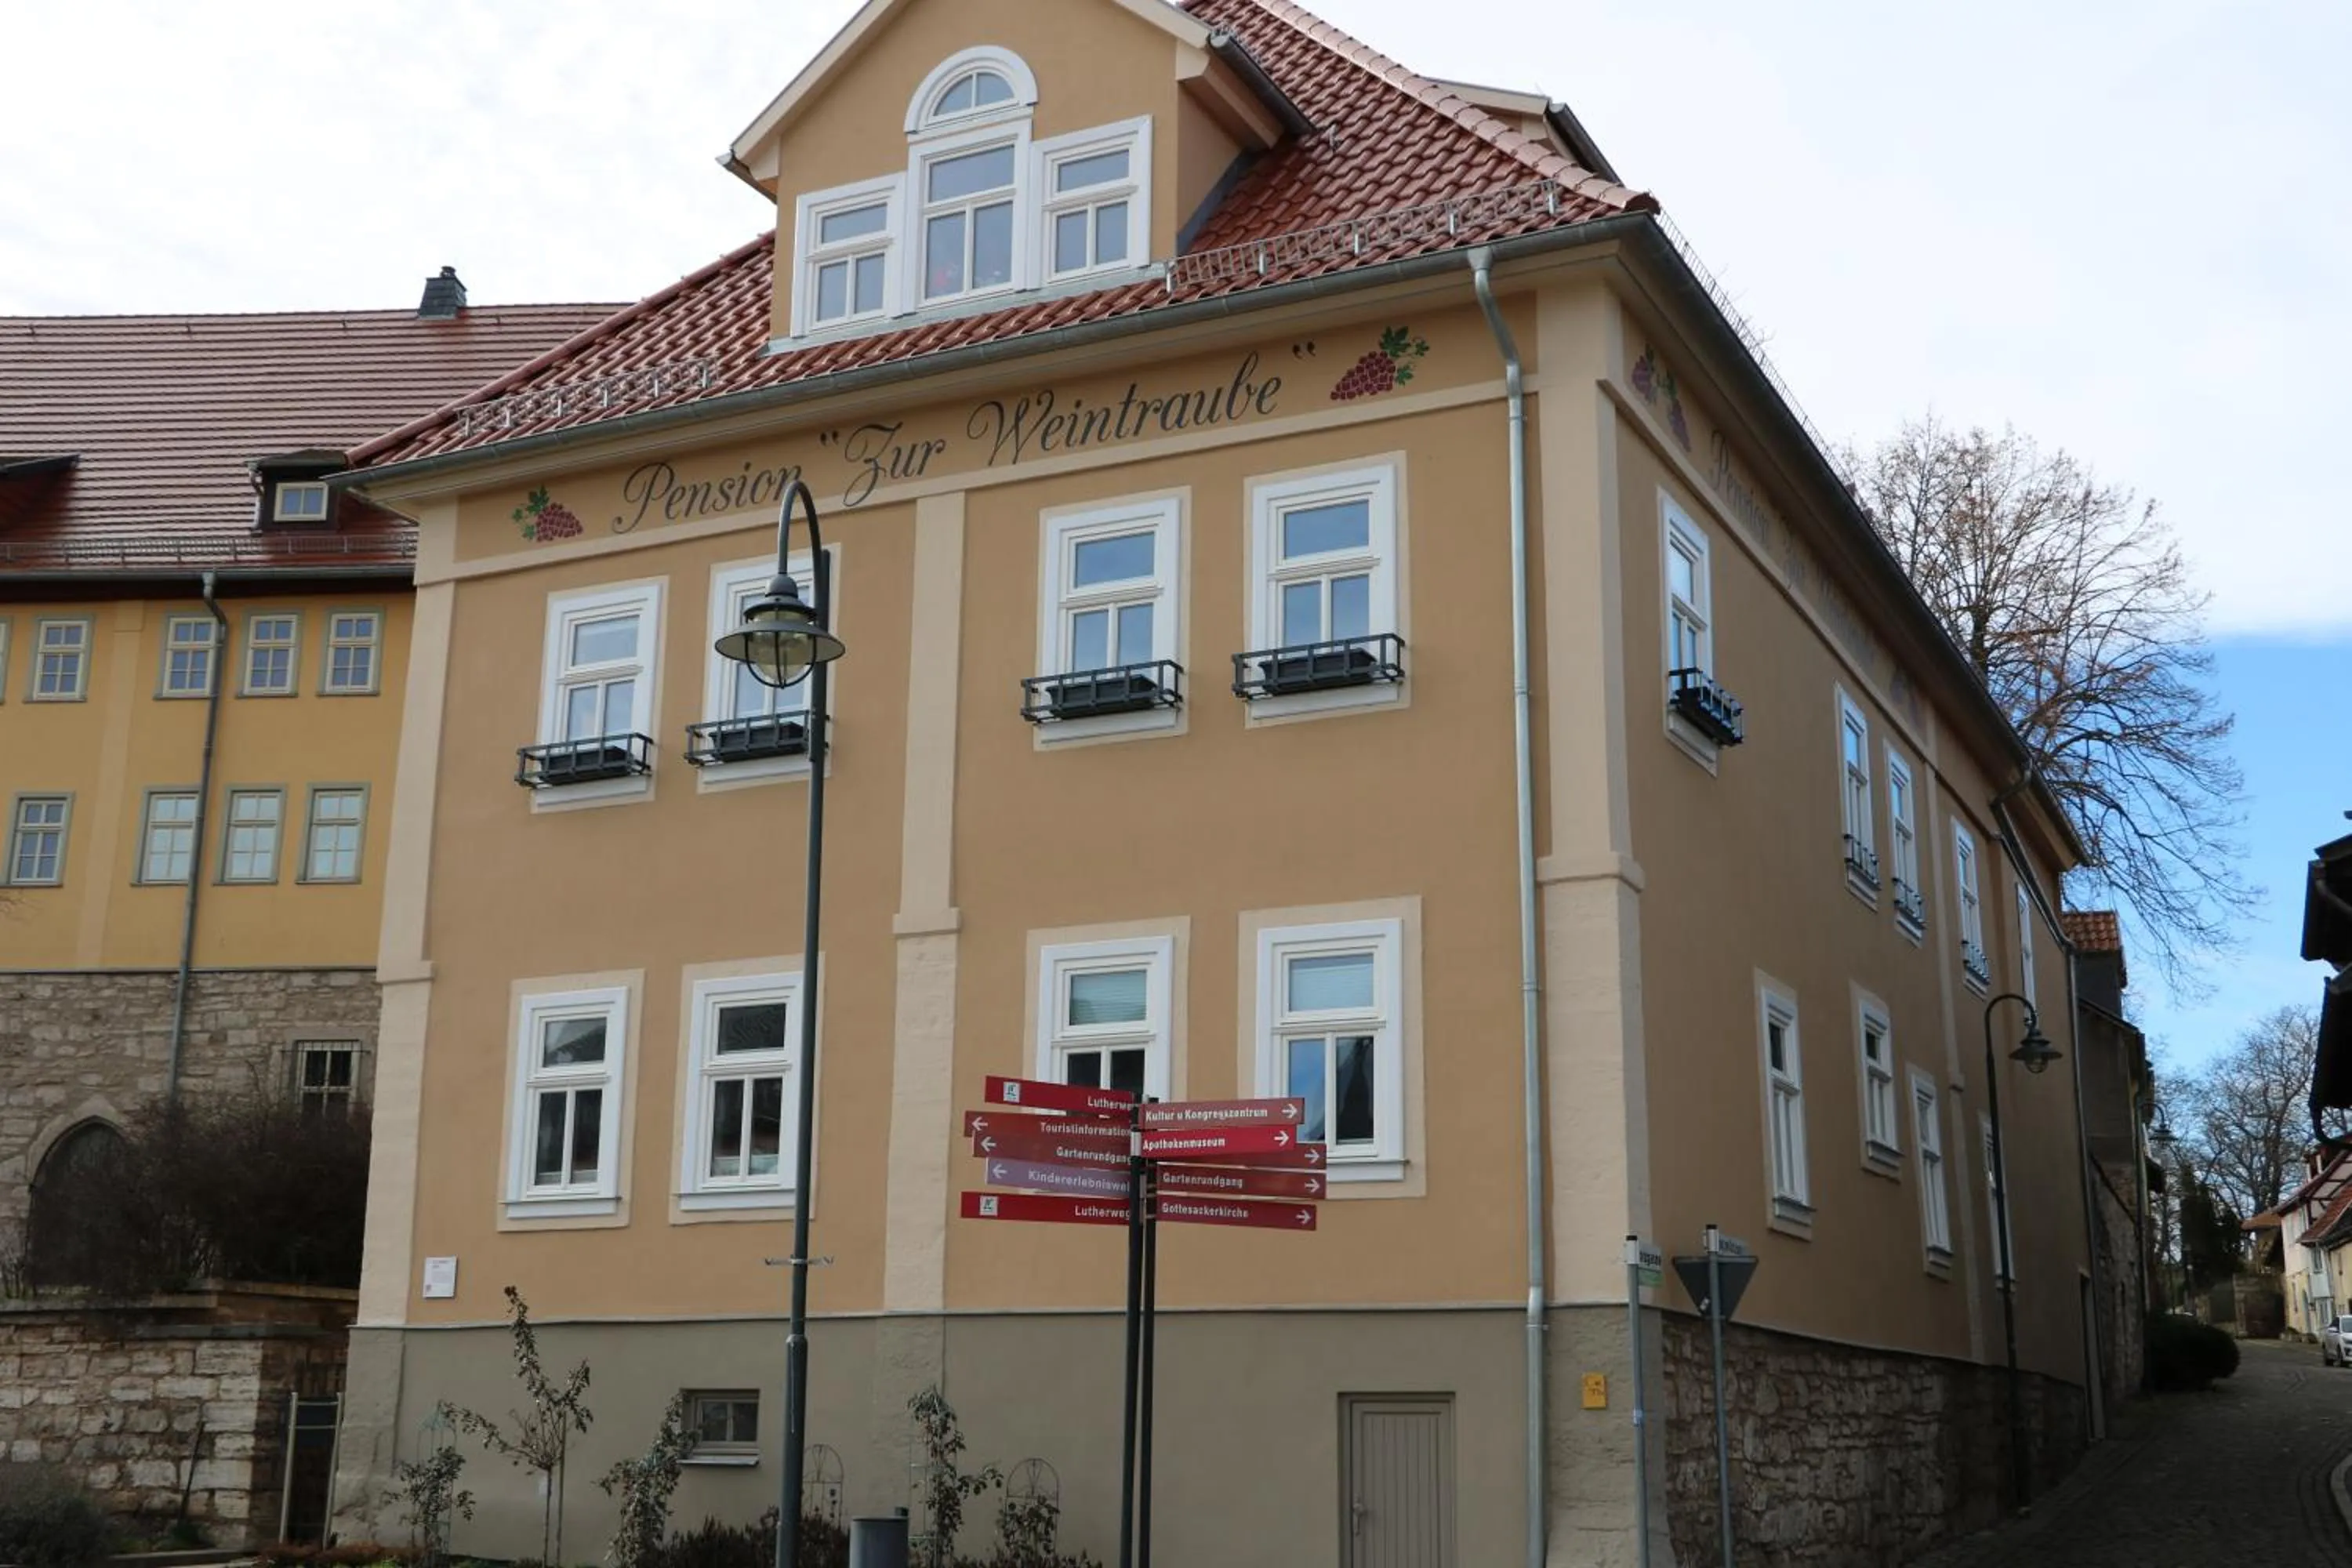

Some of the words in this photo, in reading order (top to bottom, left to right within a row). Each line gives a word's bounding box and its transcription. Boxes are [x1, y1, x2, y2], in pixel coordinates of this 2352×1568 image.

[612, 461, 802, 535] Pension
[1145, 1110, 1174, 1122] Kultur
[1143, 1138, 1225, 1151] Apothekenmuseum
[1028, 1170, 1130, 1192] Kindererlebniswel
[1163, 1172, 1243, 1188] Gartenrundgang
[1162, 1202, 1249, 1218] Gottesackerkirche
